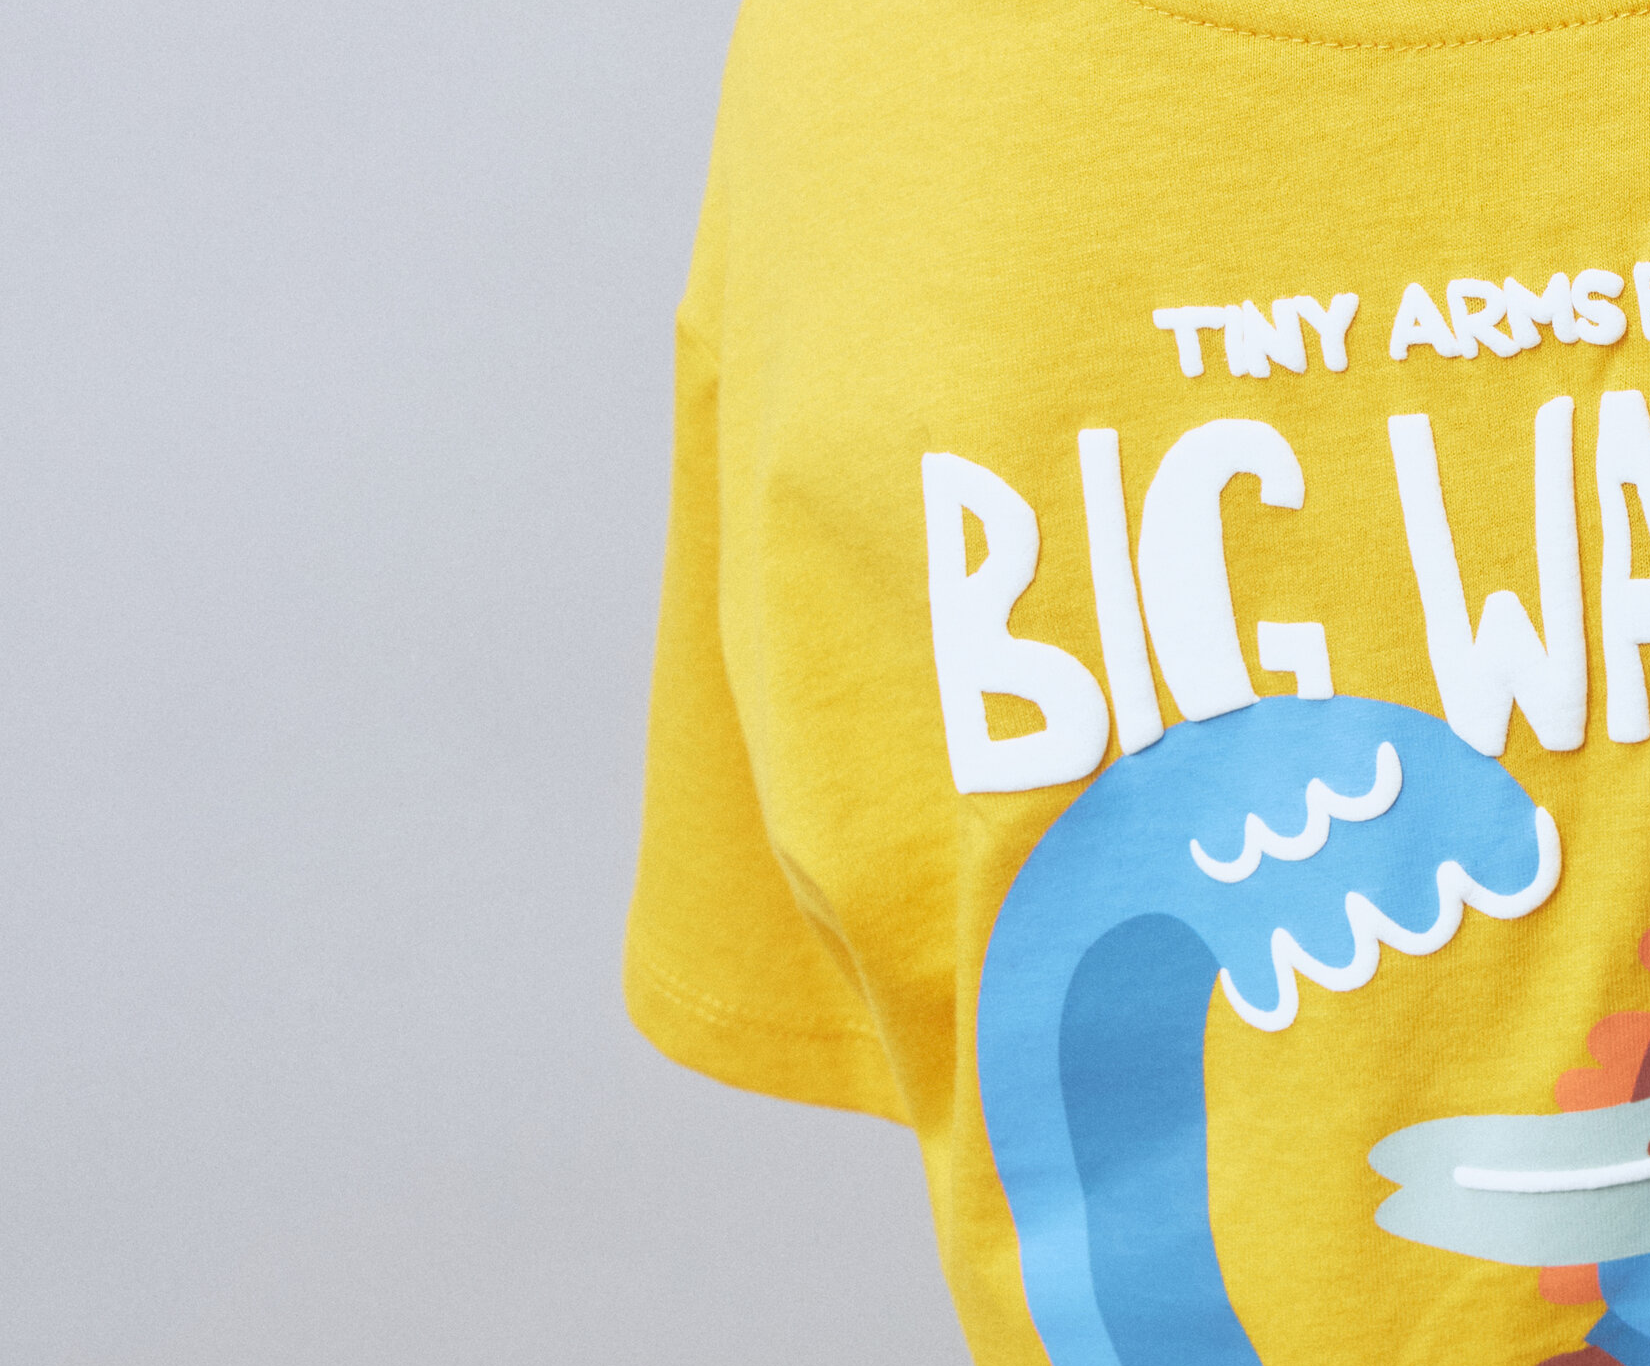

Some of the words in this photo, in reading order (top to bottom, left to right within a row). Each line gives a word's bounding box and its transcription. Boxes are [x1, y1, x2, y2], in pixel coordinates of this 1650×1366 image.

[1152, 292, 1360, 378] TINY
[1388, 268, 1627, 361] ARMS
[920, 418, 1336, 795] BIG
